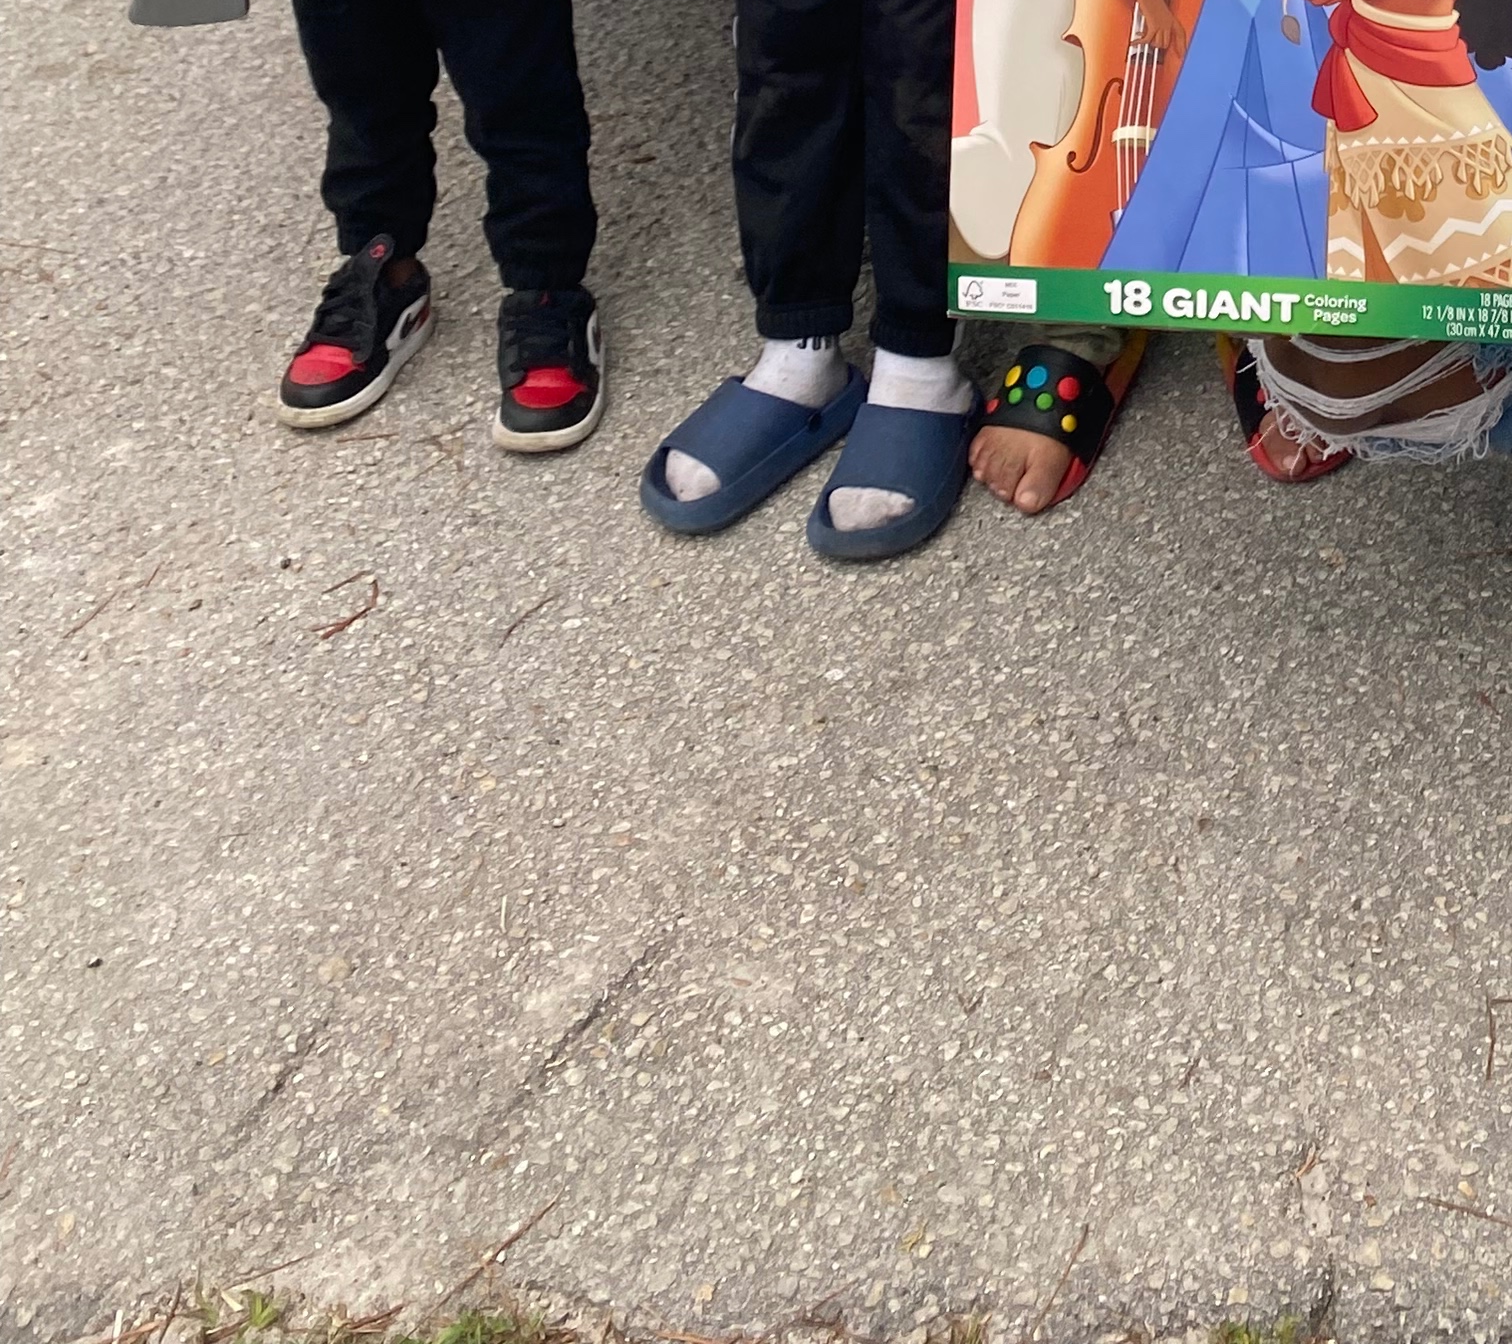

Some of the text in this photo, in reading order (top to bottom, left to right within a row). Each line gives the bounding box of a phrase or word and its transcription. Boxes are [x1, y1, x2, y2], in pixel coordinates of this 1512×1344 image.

[1103, 279, 1367, 323] 18 GIANT Coloring
[1480, 293, 1490, 307] 18
[1313, 309, 1357, 325] Pages
[1422, 305, 1433, 320] 12
[1437, 305, 1454, 320] 1/8
[1456, 307, 1466, 321] IN
[1467, 307, 1475, 321] X
[1478, 308, 1488, 321] 18
[1491, 308, 1509, 322] 7/8
[1446, 322, 1462, 338] (30
[1463, 326, 1476, 337] cm
[1478, 324, 1486, 337] X
[1488, 324, 1500, 338] 47
